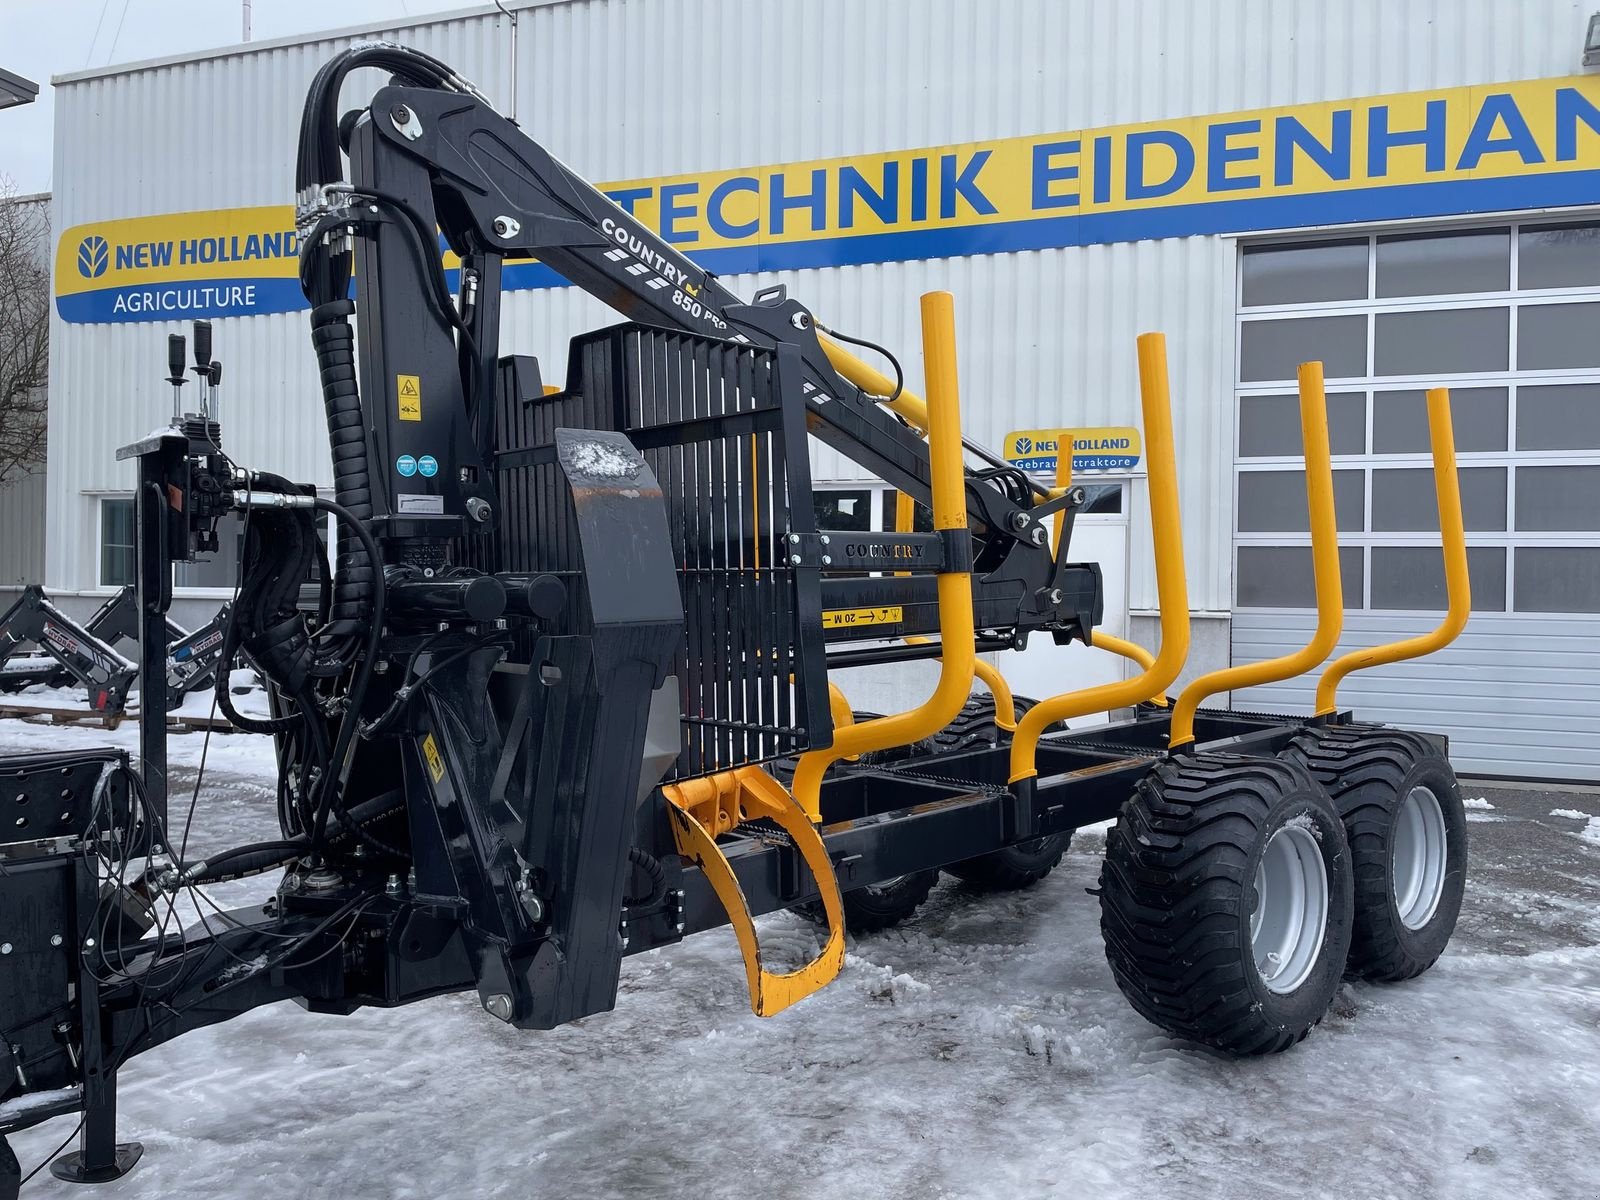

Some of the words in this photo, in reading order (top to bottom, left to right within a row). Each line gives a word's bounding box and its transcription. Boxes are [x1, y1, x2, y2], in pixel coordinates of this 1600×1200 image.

[600, 150, 999, 243] TECHNIK
[115, 241, 173, 270] NEW
[180, 230, 299, 264] HOLLAND
[601, 218, 688, 286] COUNTRY
[113, 286, 256, 313] AGRICULTURE
[672, 289, 702, 318] 850
[703, 310, 727, 329] PRO
[1015, 458, 1131, 469] Gebrauttraktore
[845, 544, 923, 558] COUNTRY
